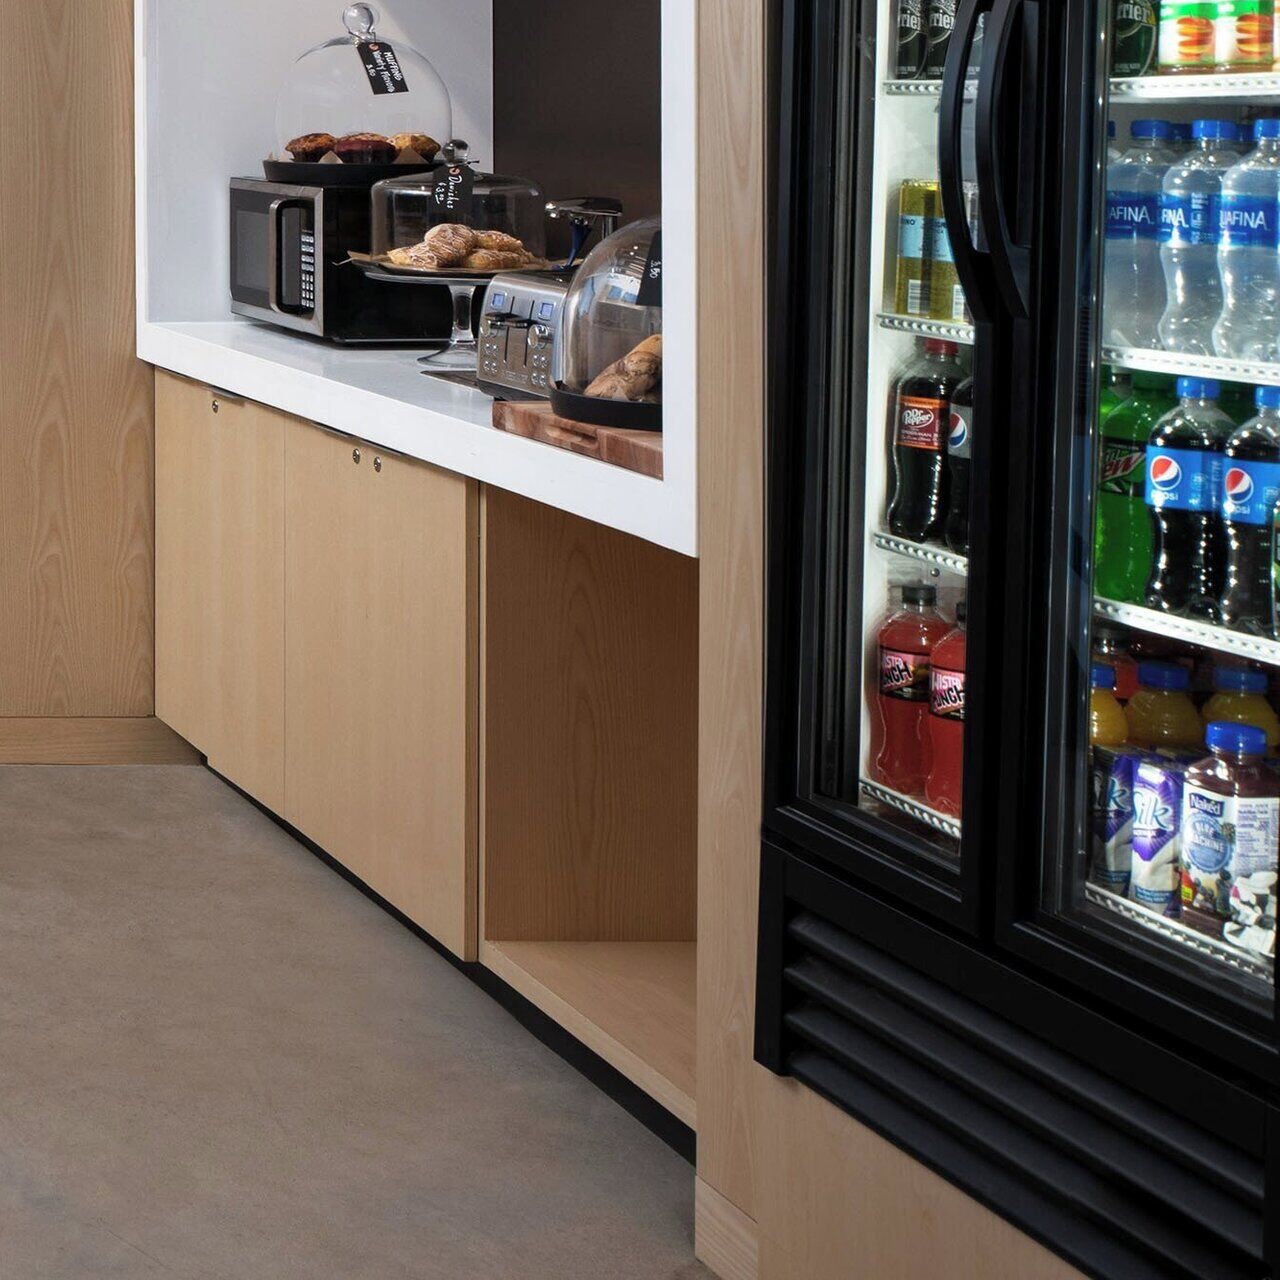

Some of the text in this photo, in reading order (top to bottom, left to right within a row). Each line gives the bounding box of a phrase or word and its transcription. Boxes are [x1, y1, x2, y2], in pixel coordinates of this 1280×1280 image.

[383, 51, 403, 81] MUFFINS
[445, 175, 462, 209] Danishes
[1190, 794, 1222, 816] Naked
